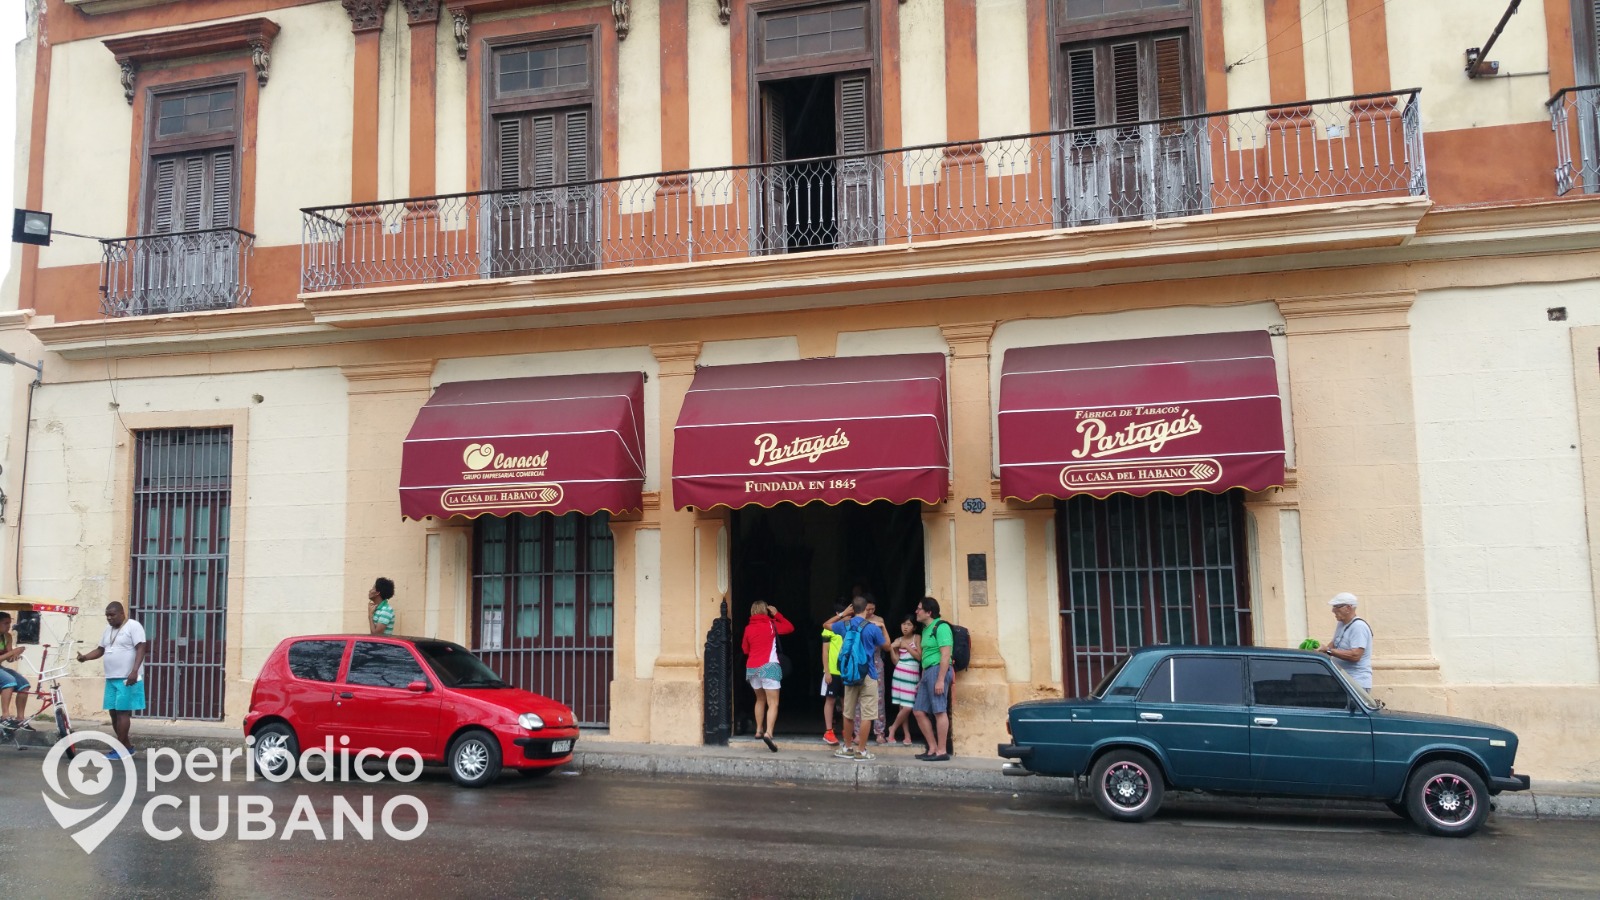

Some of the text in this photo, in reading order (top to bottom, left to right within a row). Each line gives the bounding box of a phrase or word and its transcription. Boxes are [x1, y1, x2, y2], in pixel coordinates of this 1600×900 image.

[1074, 406, 1180, 419] FÁBRICA DE TABACOS
[1071, 408, 1203, 459] Partagás
[748, 427, 850, 467] Partagás
[493, 450, 549, 469] Caracol
[482, 471, 515, 480] EMPRESARIAL
[516, 470, 545, 478] COMERCIAL
[1071, 468, 1187, 483] LA CASA DEL HABANO
[744, 478, 857, 493] FUNDADA EN 1845
[449, 491, 538, 504] LA CASA DEL HABANO
[966, 501, 982, 511] 520
